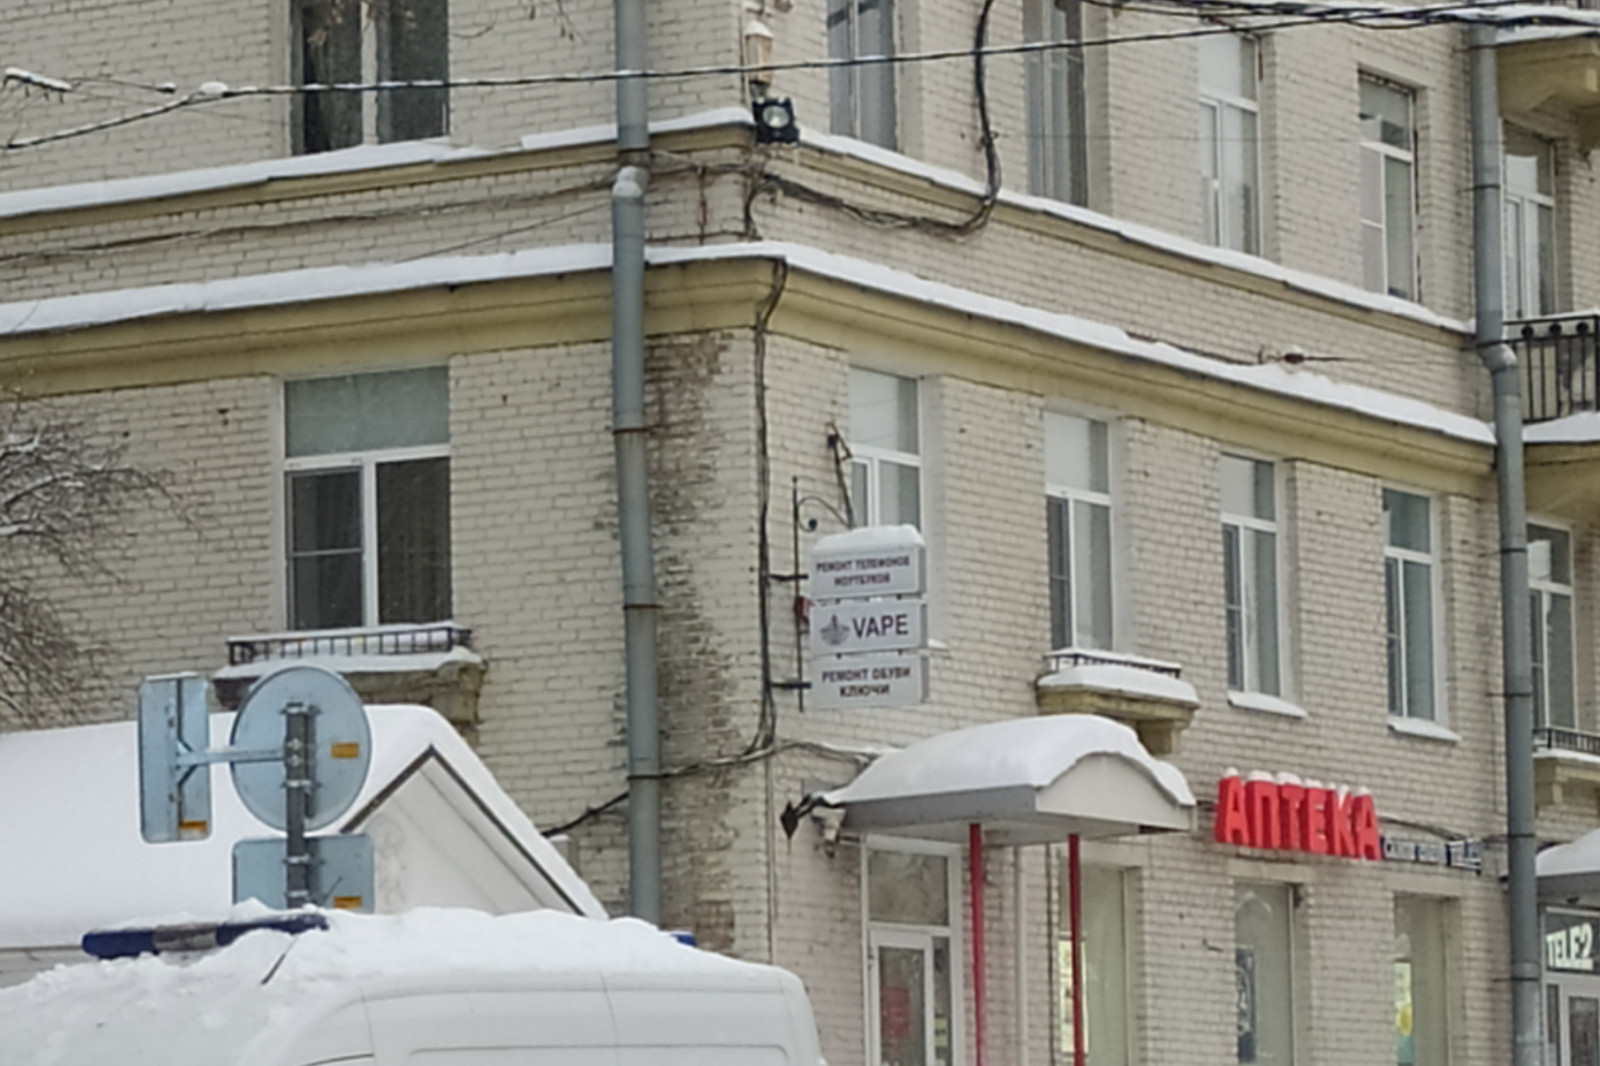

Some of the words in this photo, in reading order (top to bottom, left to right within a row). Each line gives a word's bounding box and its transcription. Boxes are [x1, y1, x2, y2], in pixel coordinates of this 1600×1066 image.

[816, 560, 852, 573] РЕМОНТ
[856, 555, 909, 570] ТЕЛЕФОНОВ
[834, 572, 891, 587] НОУТБУКОВ
[851, 613, 910, 639] VAPE
[821, 668, 868, 683] РЕМОНТ
[872, 665, 911, 680] ОБУВИ
[839, 684, 890, 698] КЛЮЧИ
[1214, 774, 1384, 862] АПТЕКА
[1545, 922, 1594, 970] TELE2
